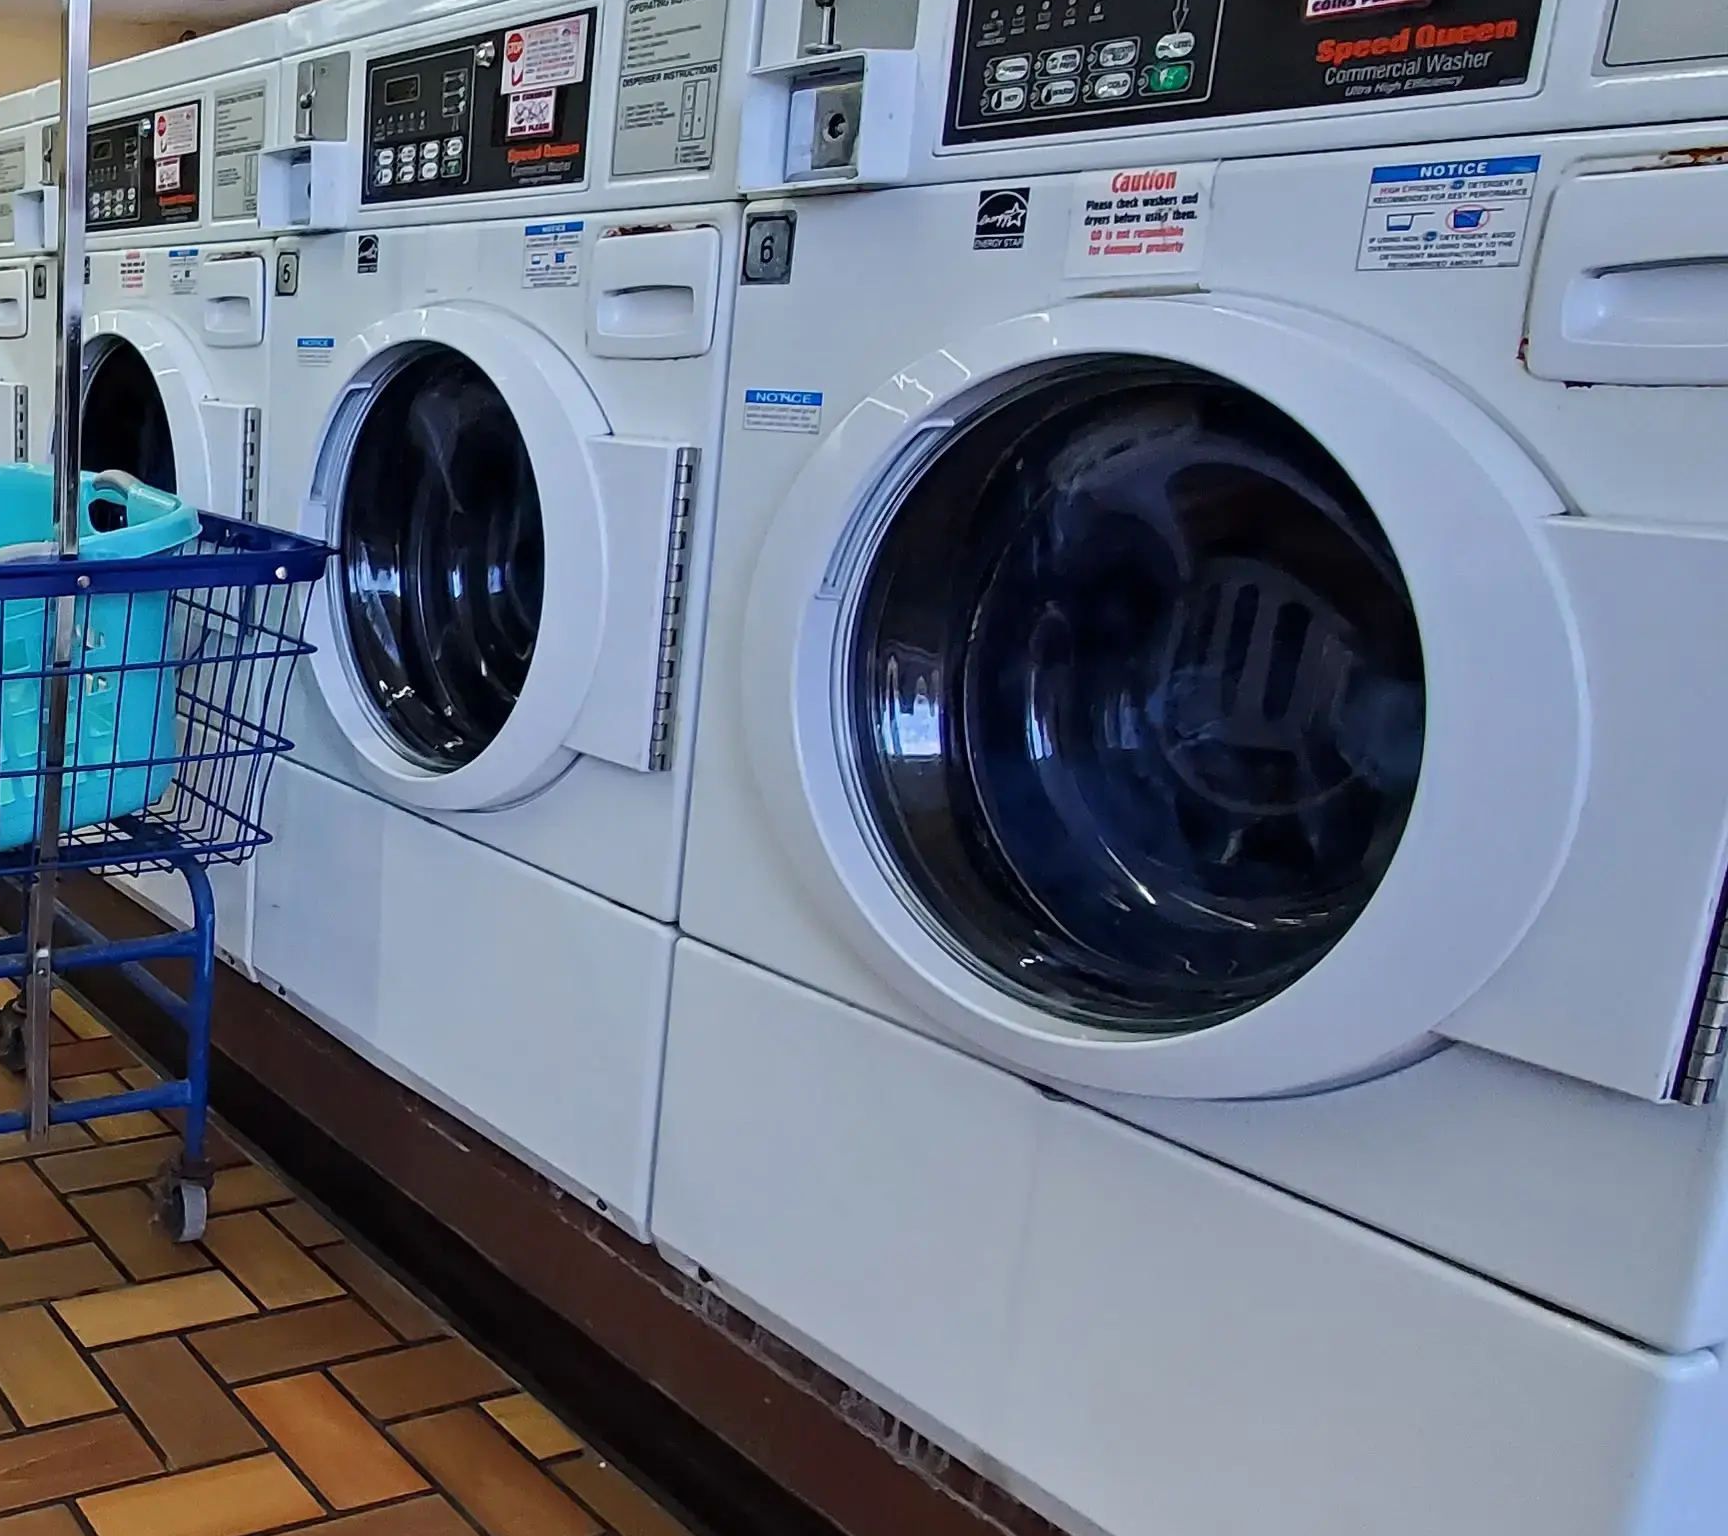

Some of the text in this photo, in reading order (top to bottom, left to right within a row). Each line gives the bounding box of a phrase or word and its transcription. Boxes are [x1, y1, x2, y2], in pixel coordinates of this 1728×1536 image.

[1316, 19, 1519, 67] Speed Queen
[663, 63, 718, 80] INSTRUCTIONS
[1324, 50, 1494, 86] Commercial Washer
[1344, 82, 1372, 97] Ultra
[1374, 80, 1402, 96] High
[1420, 162, 1488, 178] NOTICE
[1112, 170, 1177, 193] Caution
[1086, 192, 1199, 212] Please check washers and
[1430, 192, 1446, 200] FOR
[1084, 214, 1111, 227] dryers
[1114, 212, 1142, 224] before
[1145, 212, 1169, 223] using
[760, 236, 774, 264] 6
[974, 237, 1023, 249] ENERGY STAR
[283, 263, 291, 284] 6
[755, 391, 812, 404] NOTICE
